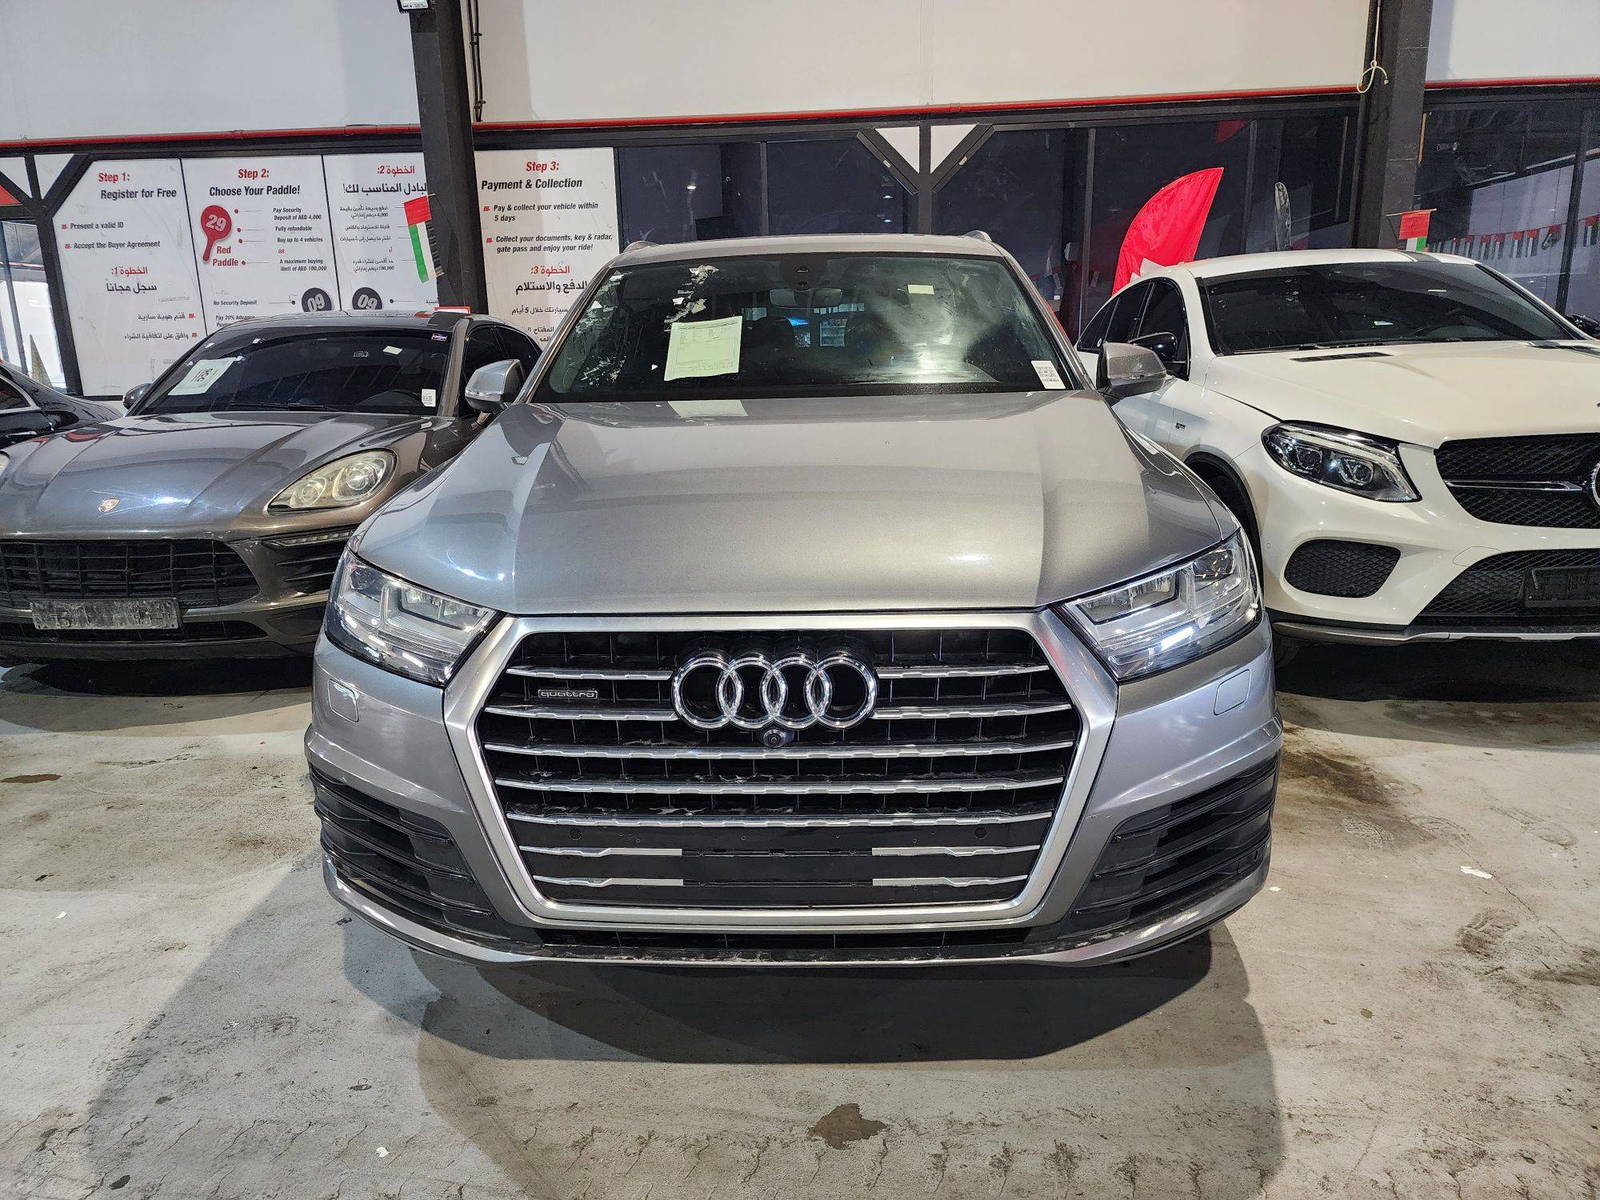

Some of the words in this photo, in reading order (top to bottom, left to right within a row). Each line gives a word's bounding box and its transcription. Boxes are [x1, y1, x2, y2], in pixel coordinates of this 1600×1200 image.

[386, 166, 415, 177] الخطوة
[526, 161, 547, 173] Step
[550, 161, 560, 171] 3:
[98, 172, 118, 183] Step
[122, 172, 130, 181] 1:
[238, 168, 258, 180] Step
[260, 168, 270, 178] 2:
[209, 186, 242, 196] Choose
[244, 186, 264, 196] Your
[266, 185, 300, 195] Paddle!
[342, 184, 359, 194] لك!
[362, 183, 402, 196] المناسب
[481, 179, 522, 191] Payment
[525, 179, 533, 189] &
[535, 178, 583, 189] Collection
[100, 190, 138, 200] Register
[142, 189, 154, 198] for
[156, 188, 177, 198] Free
[206, 214, 227, 232] 29
[496, 235, 518, 243] Collect
[216, 246, 232, 254] Red
[497, 246, 511, 254] gate
[543, 244, 560, 253] enjoy
[212, 258, 239, 267] Paddle
[120, 266, 148, 277] الخطوة
[541, 265, 570, 277] الخطوة
[133, 282, 157, 294] سجل
[515, 281, 560, 295] والاستلام
[308, 293, 325, 312] 09
